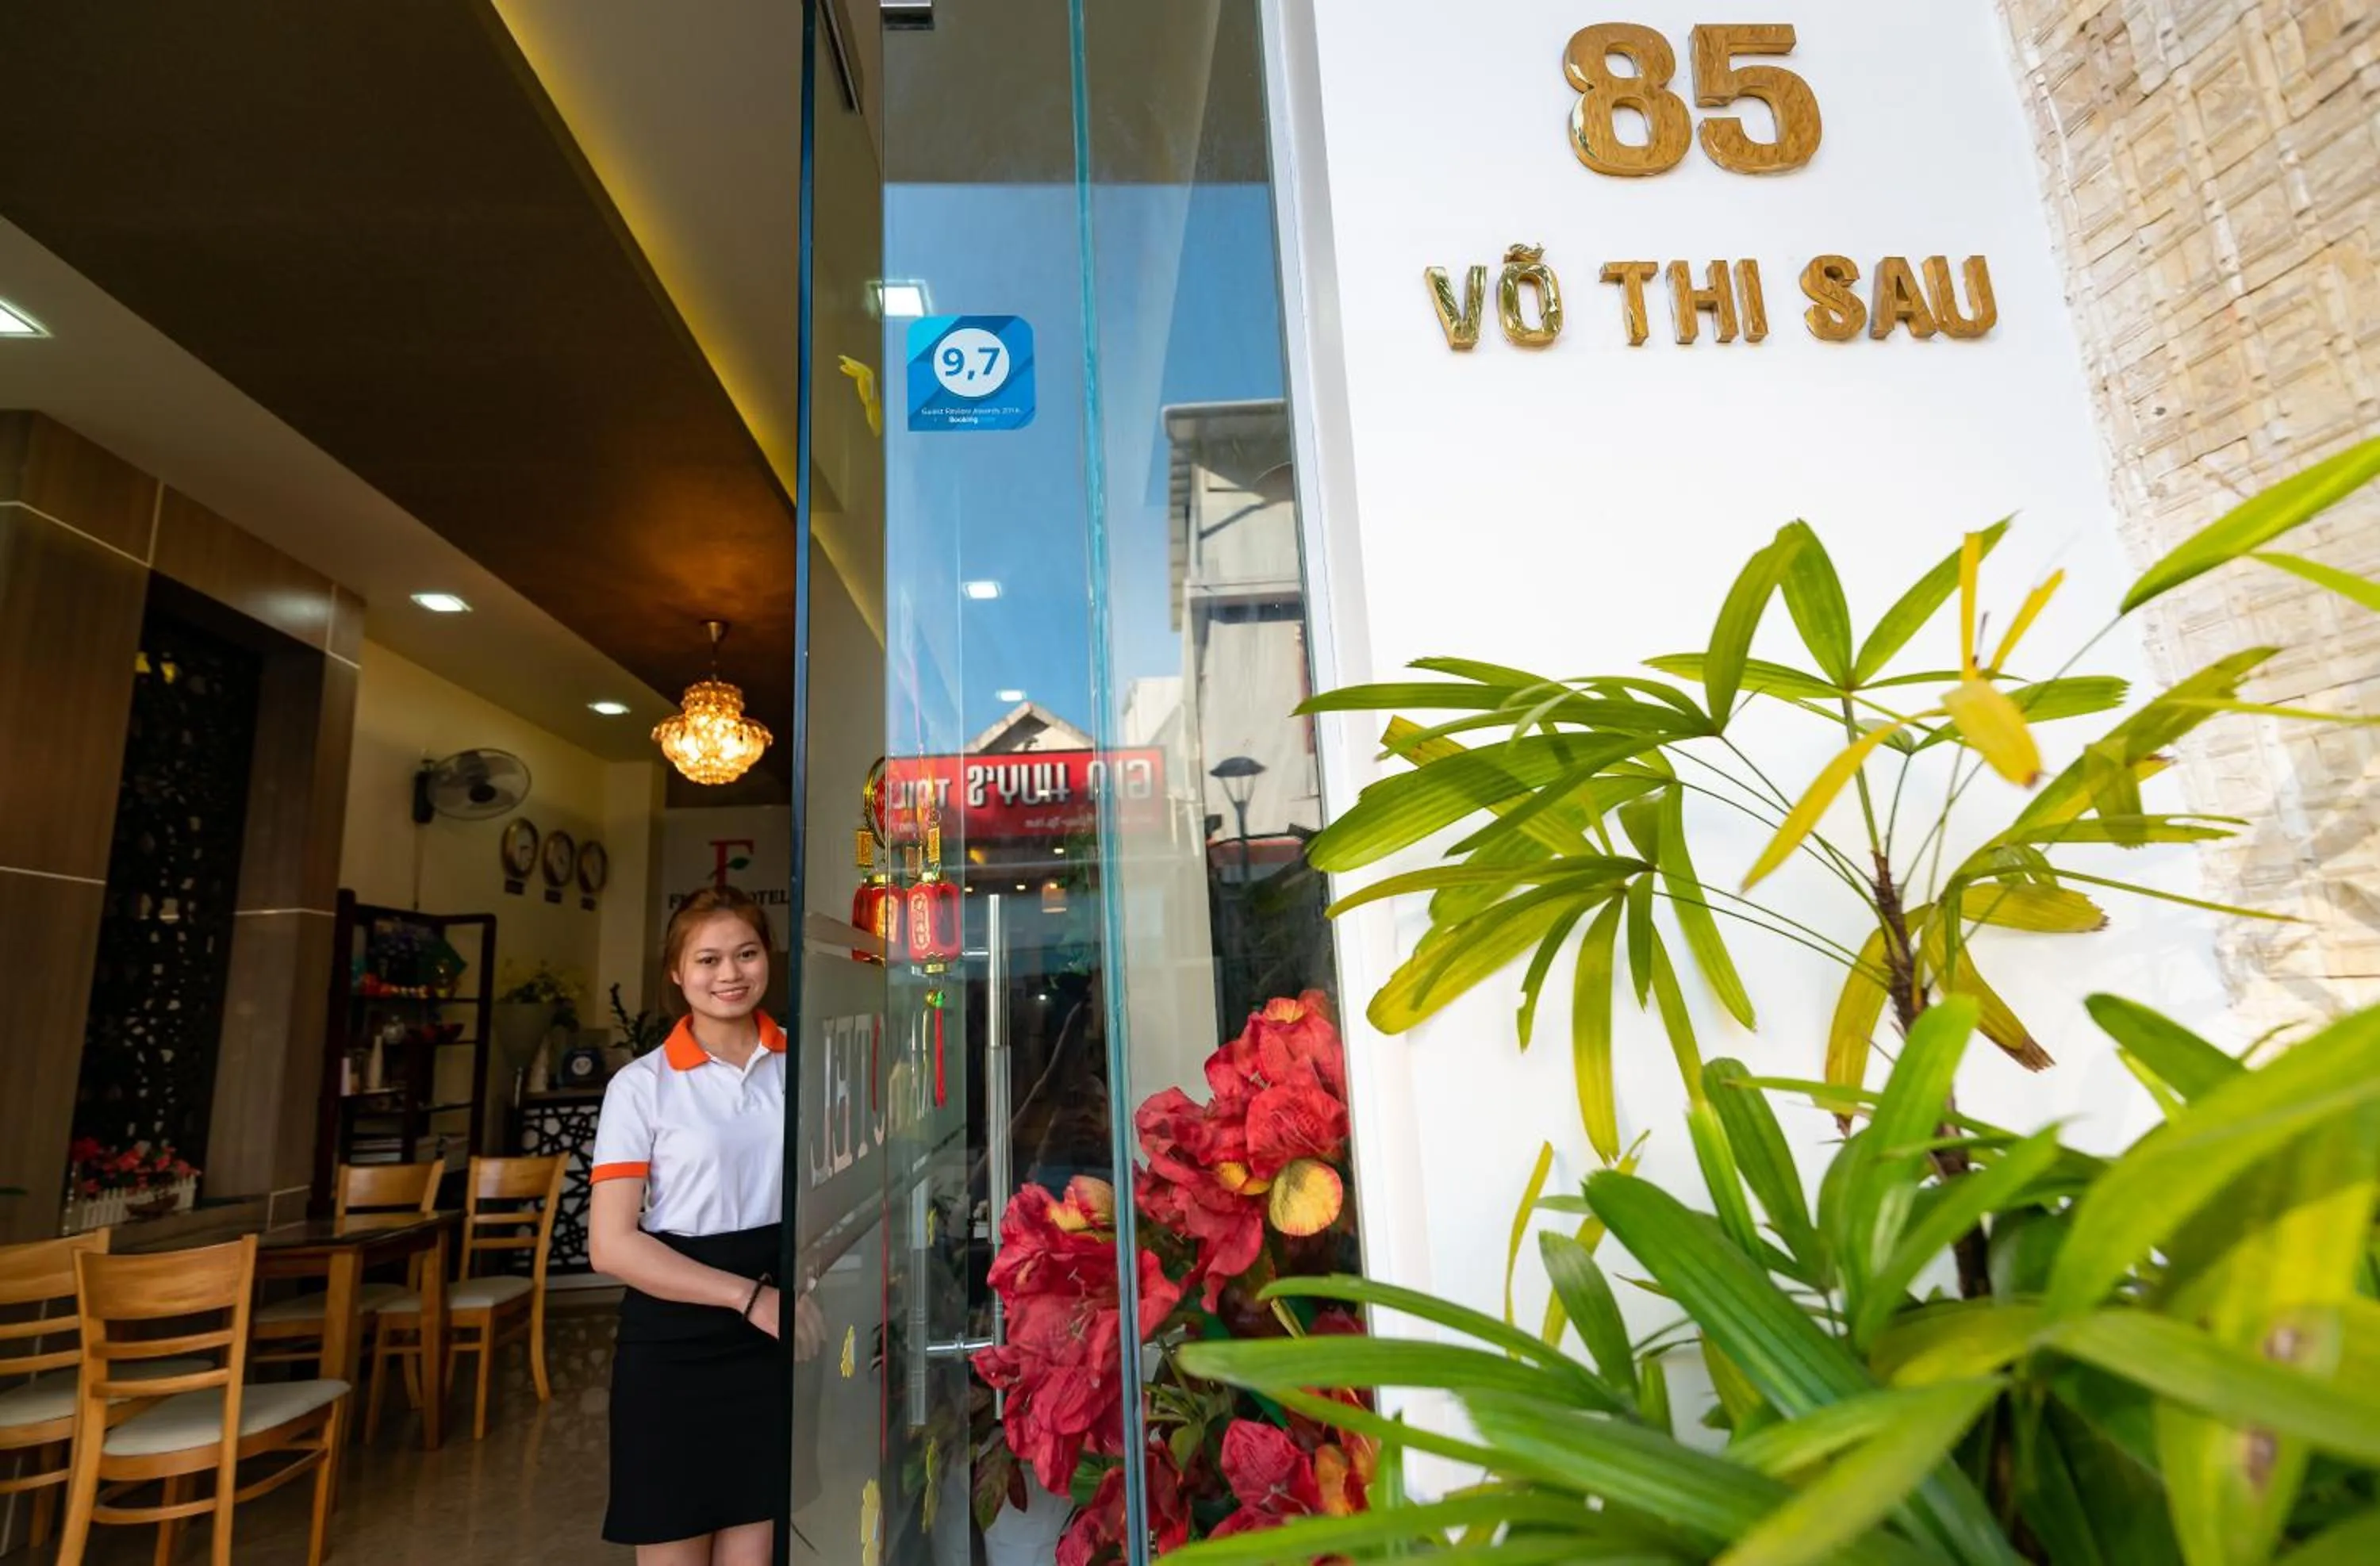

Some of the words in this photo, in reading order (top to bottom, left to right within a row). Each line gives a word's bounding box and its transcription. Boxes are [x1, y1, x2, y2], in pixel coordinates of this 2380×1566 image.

[1563, 21, 1822, 177] 85
[1599, 259, 1769, 347] THI
[1798, 254, 1999, 343] SAU
[942, 347, 1000, 380] 9,7
[945, 407, 972, 416] Review
